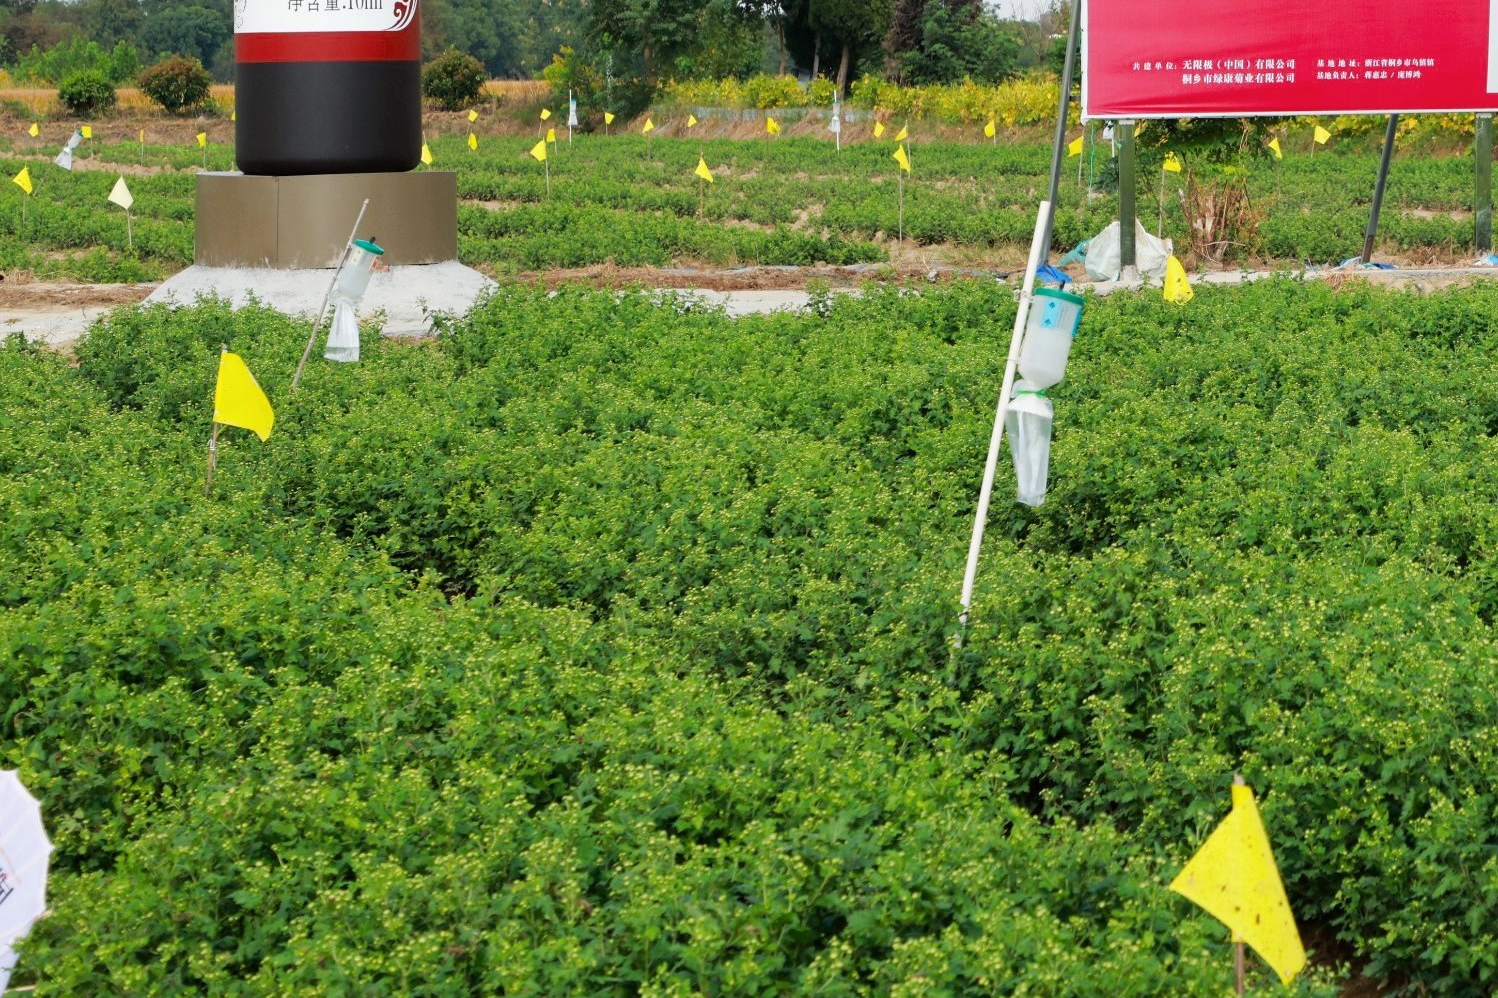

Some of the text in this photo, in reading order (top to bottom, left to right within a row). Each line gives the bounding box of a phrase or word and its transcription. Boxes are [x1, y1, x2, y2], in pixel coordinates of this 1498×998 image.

[1181, 73, 1296, 86] 桐乡市绿康菊业有限公司
